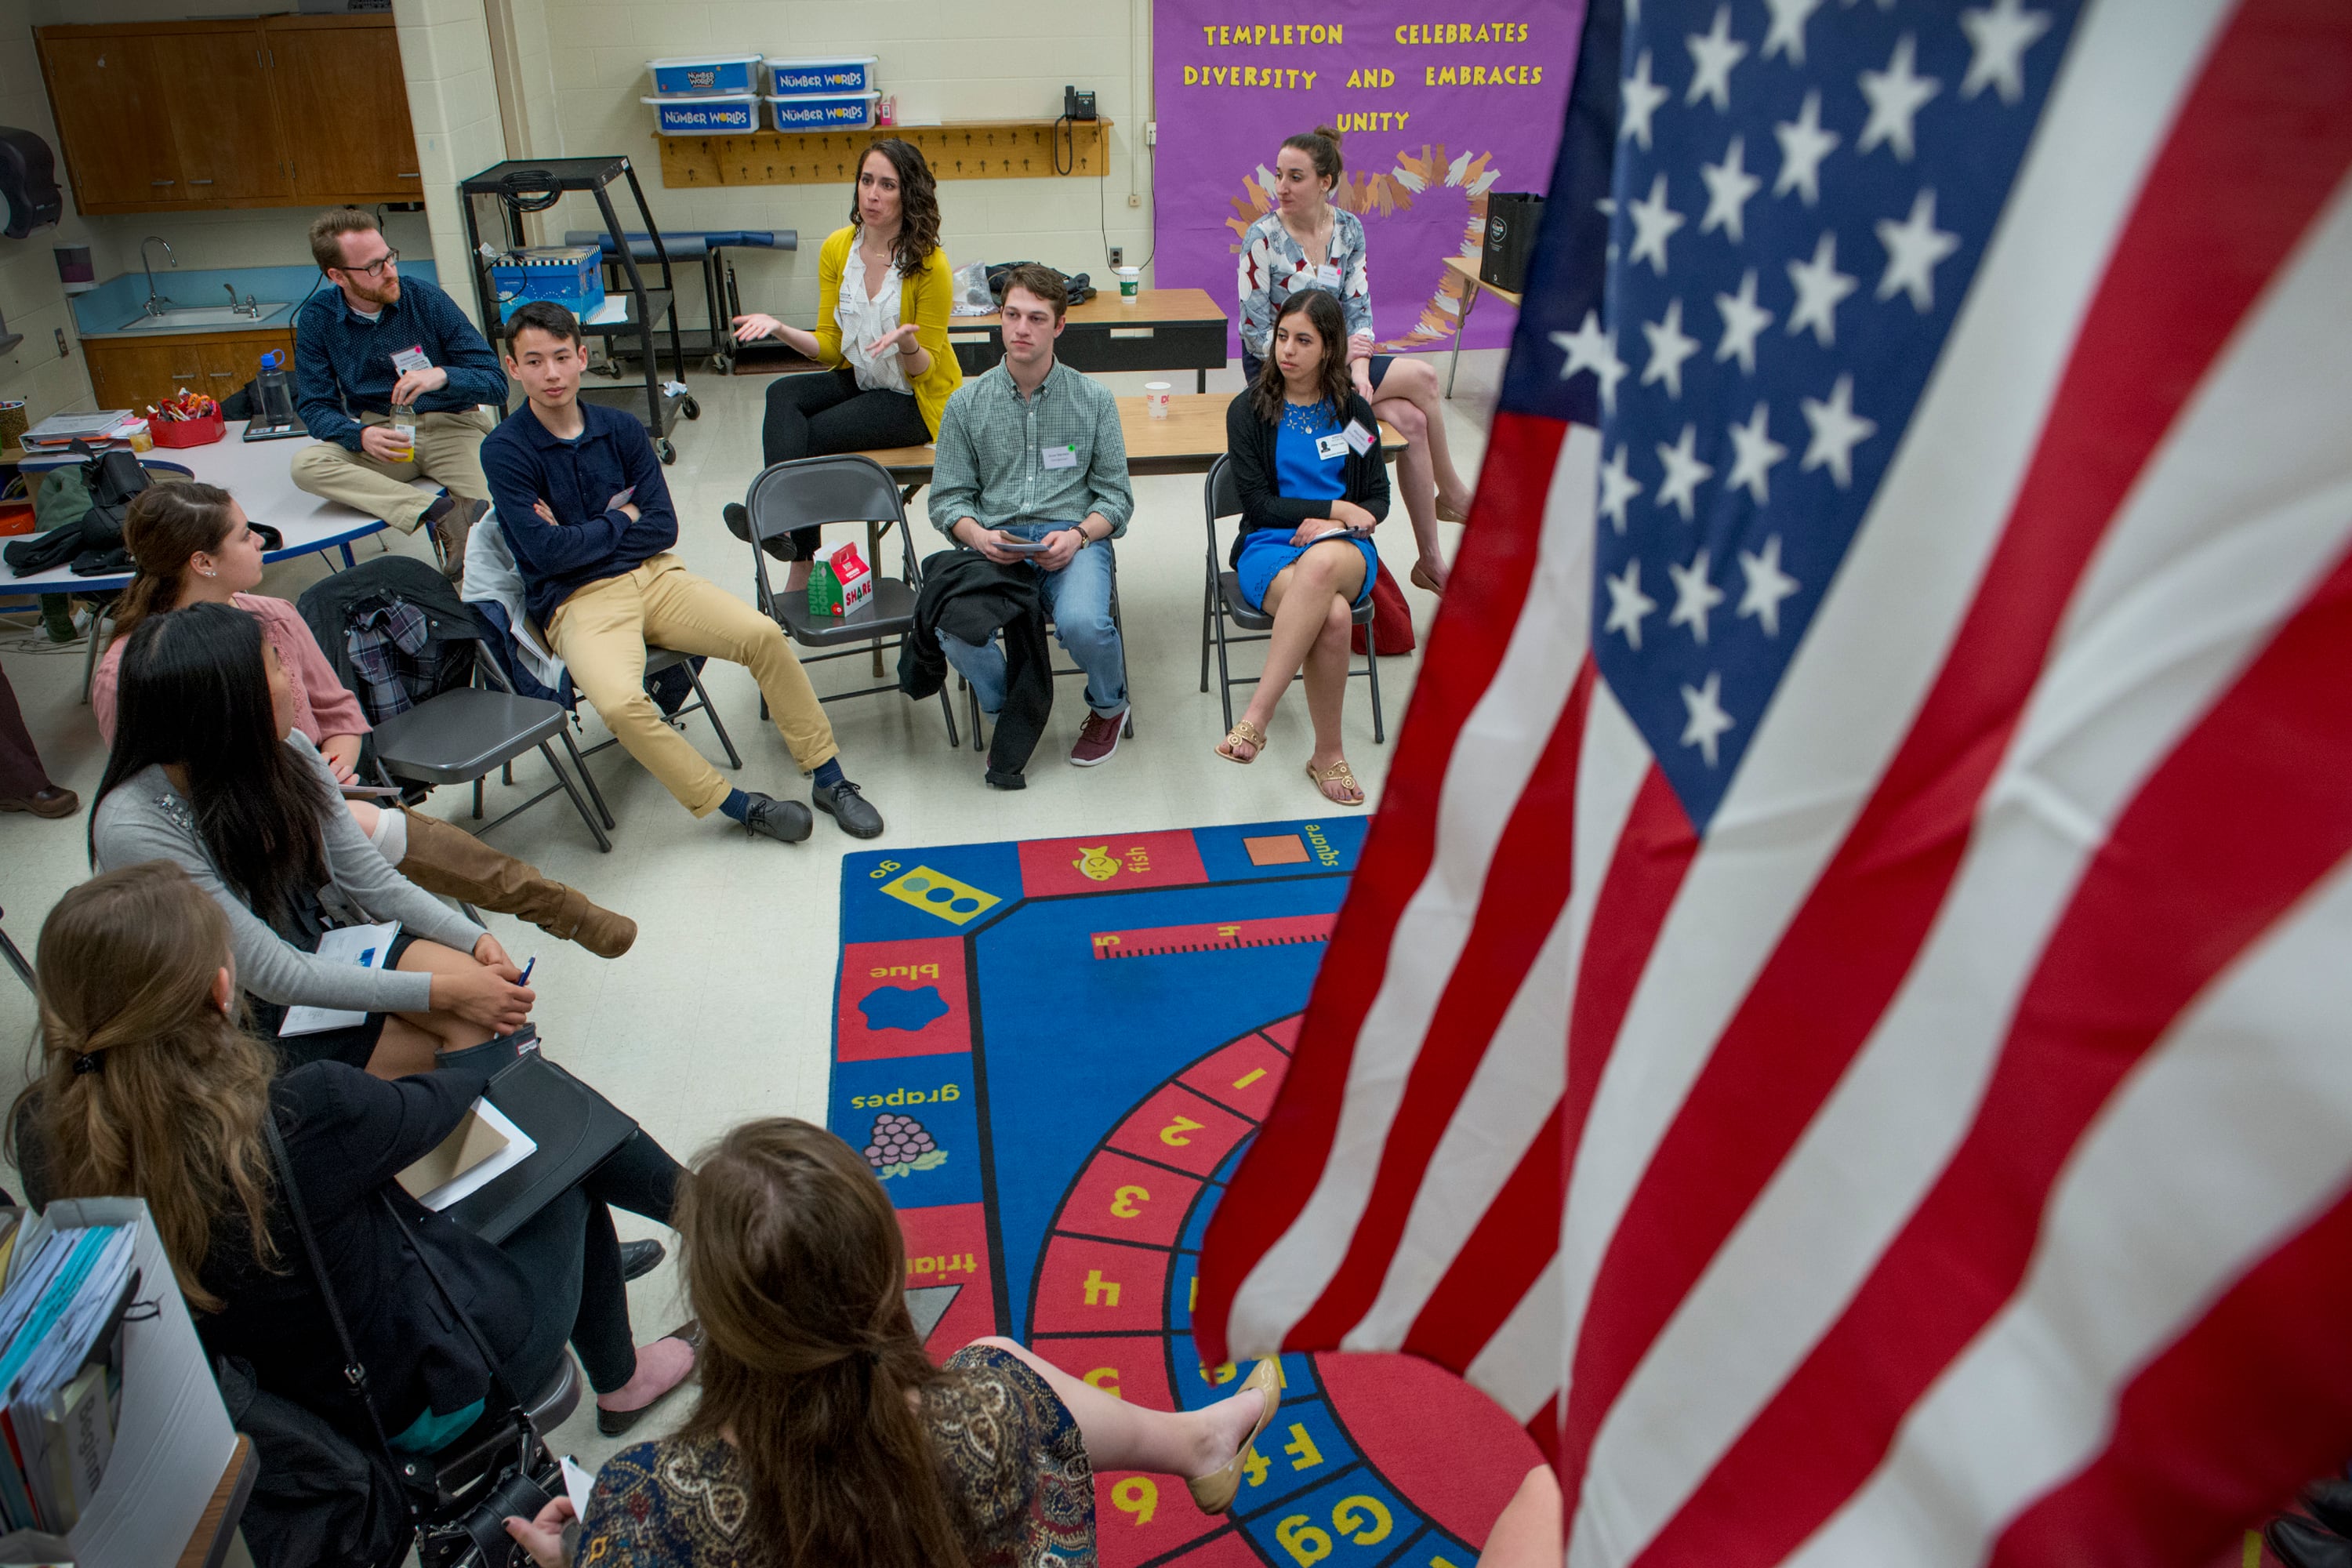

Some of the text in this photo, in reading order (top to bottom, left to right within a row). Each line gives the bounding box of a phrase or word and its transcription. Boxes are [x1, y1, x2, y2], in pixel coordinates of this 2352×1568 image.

[1203, 23, 1528, 45] TEMPLETON CELEBRATES
[1184, 65, 1542, 89] DIVERSITY AND EMBRACES
[1337, 112, 1409, 132] UNITY
[845, 580, 872, 606] SHARE
[1305, 824, 1340, 866] square
[869, 860, 902, 879] go
[1127, 847, 1150, 873] fish
[1094, 926, 1241, 946] 5 4
[870, 963, 939, 980] blue
[851, 1083, 960, 1109] grapes
[1160, 1116, 1205, 1146] 2
[1110, 1185, 1150, 1218] 3
[1083, 1269, 1121, 1307] 4
